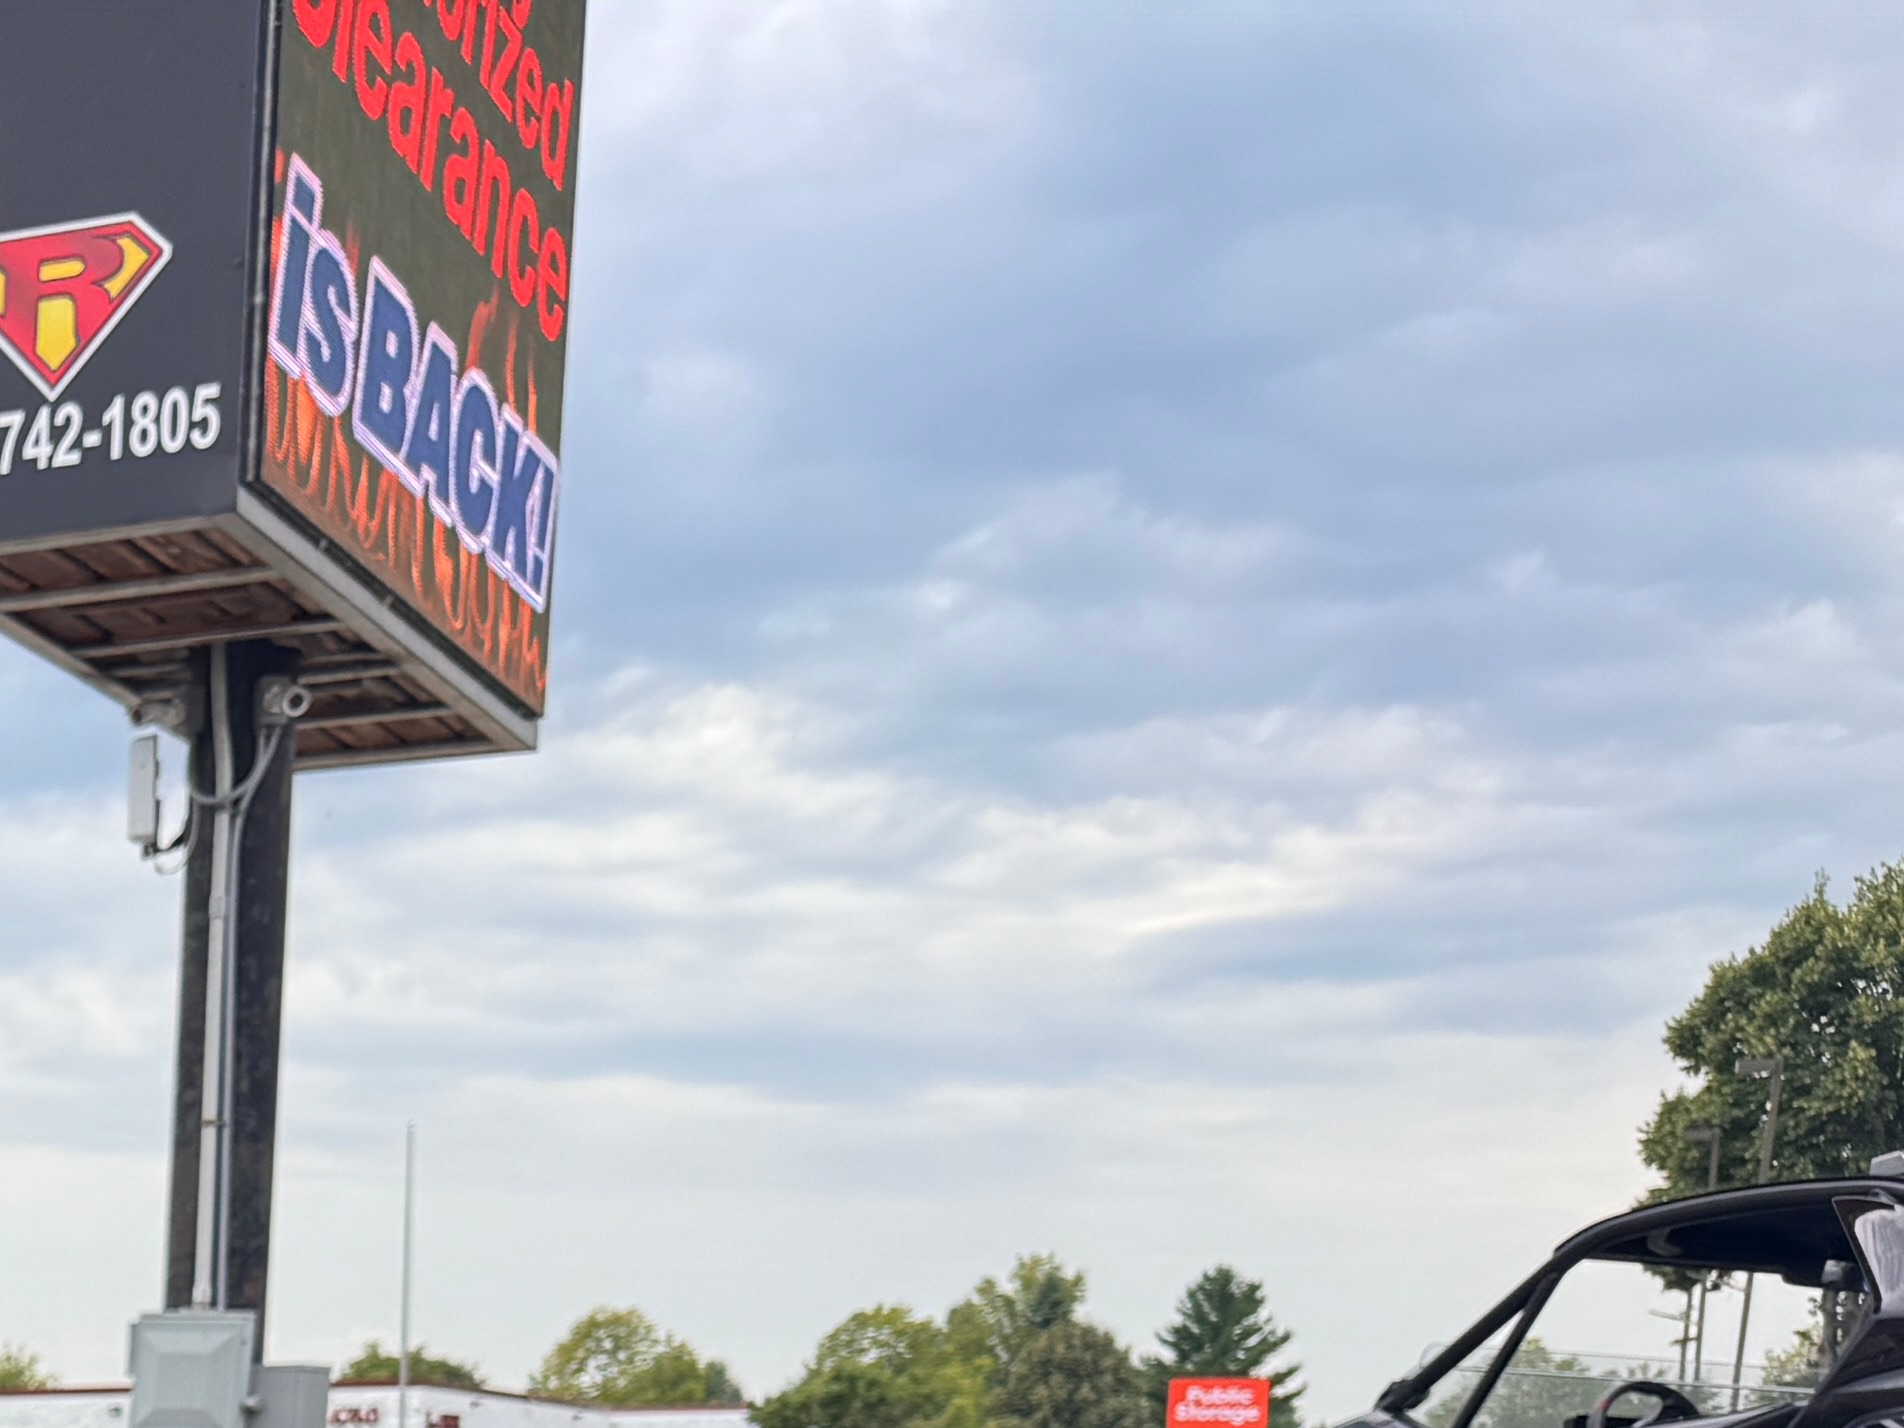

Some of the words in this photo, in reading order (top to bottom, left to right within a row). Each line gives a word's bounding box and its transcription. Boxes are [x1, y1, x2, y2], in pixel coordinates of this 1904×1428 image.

[293, 0, 568, 342] learance
[352, 255, 559, 614] BACK!
[1175, 1401, 1260, 1426] Storage
